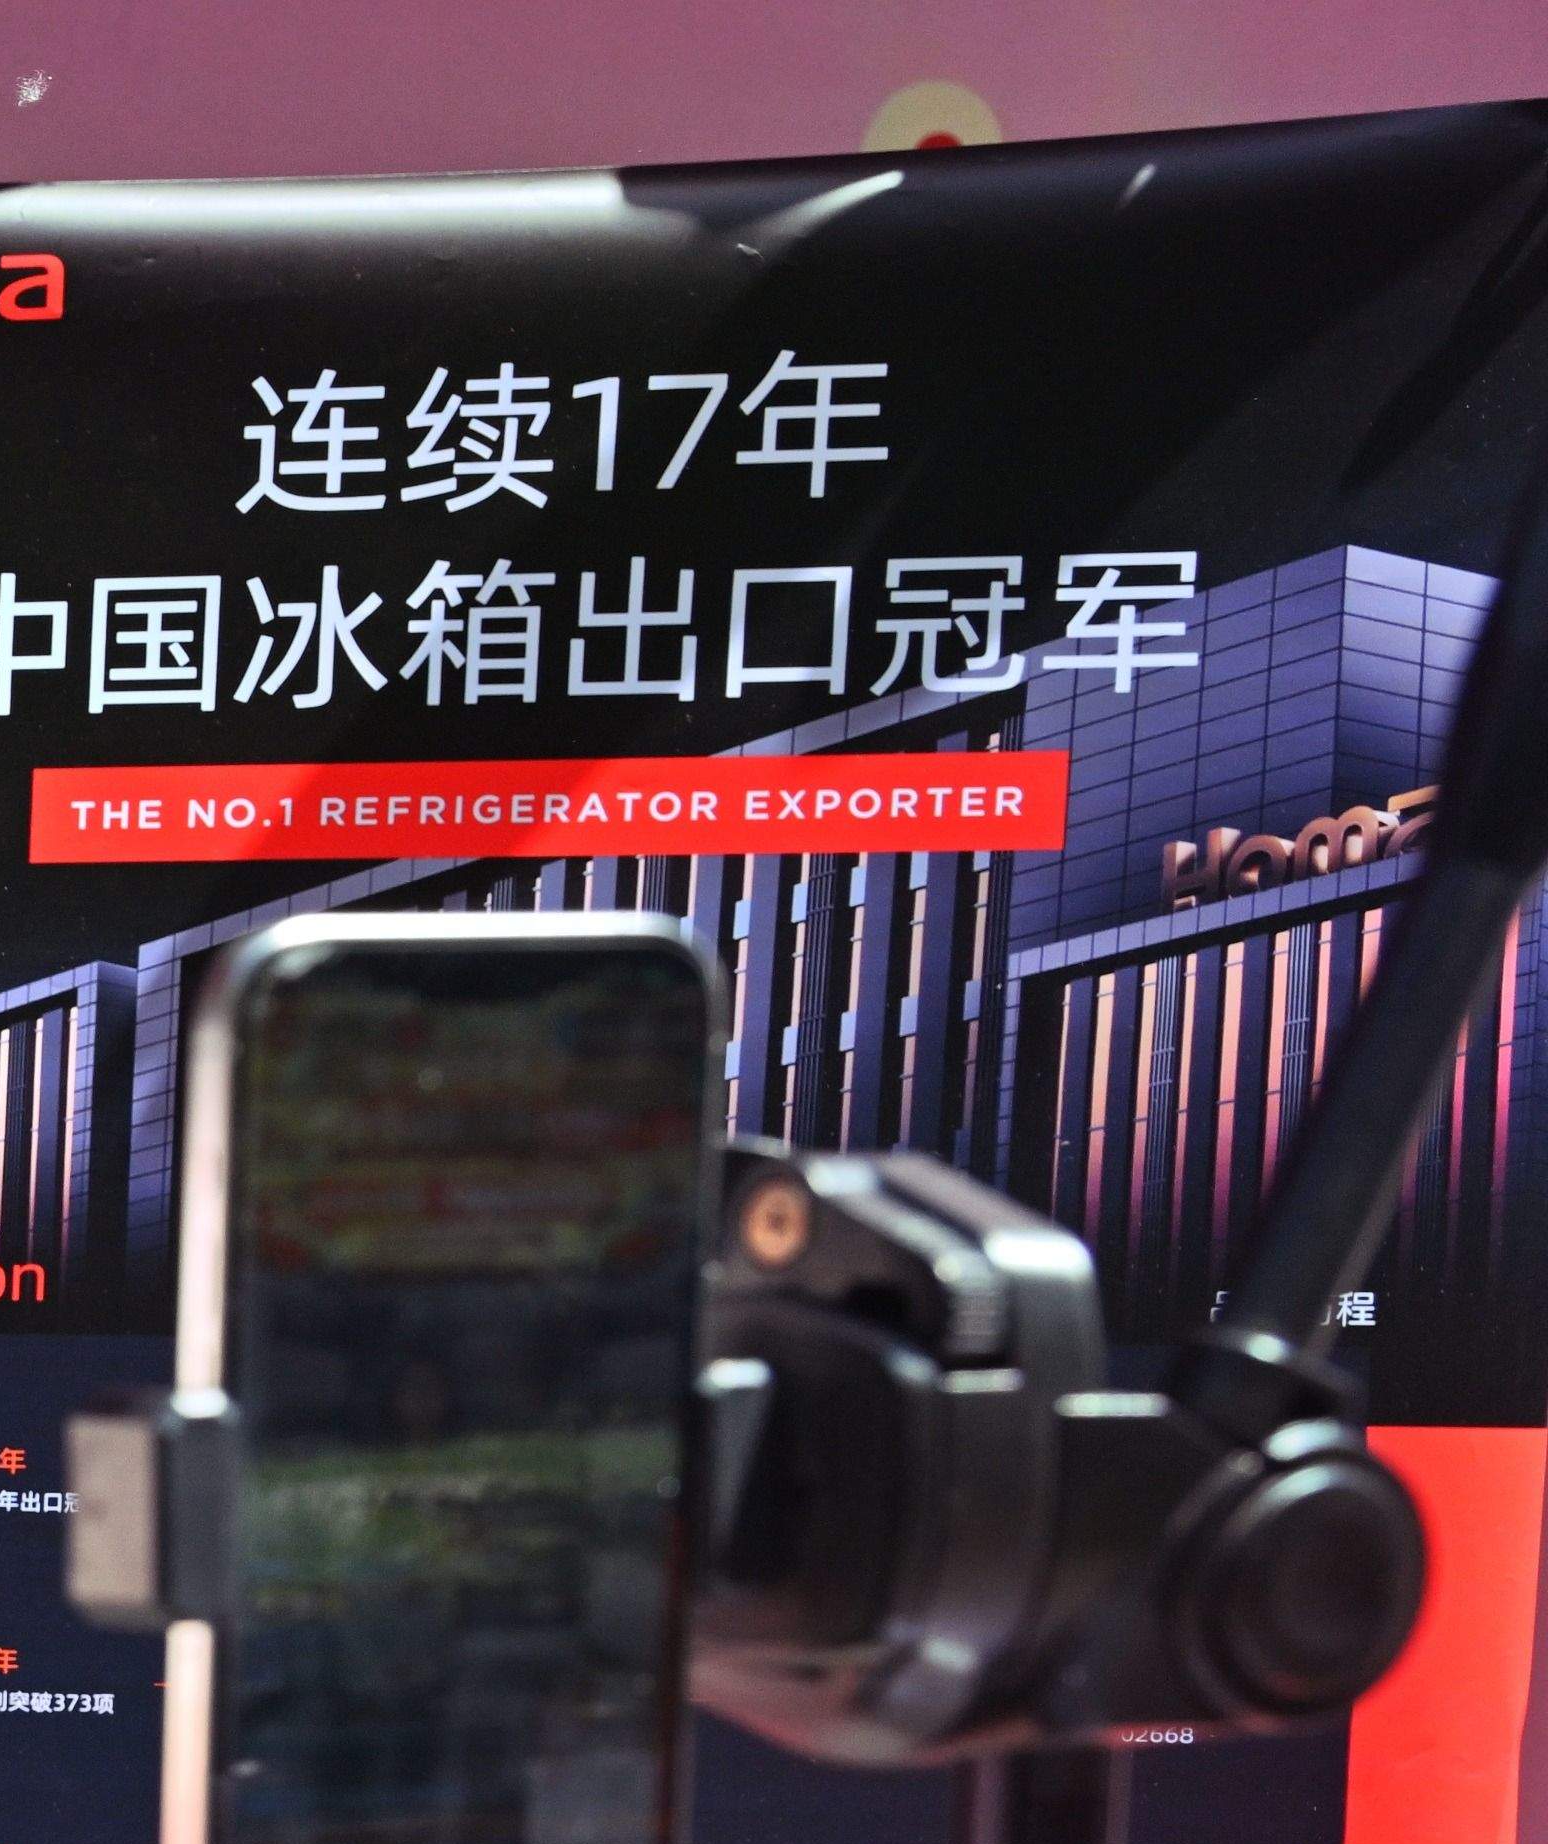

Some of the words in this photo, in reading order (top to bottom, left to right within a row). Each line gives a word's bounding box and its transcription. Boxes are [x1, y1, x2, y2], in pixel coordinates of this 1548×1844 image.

[236, 351, 889, 514] 连续17年
[71, 801, 162, 832] THE
[186, 798, 294, 830] NO.1
[319, 790, 718, 827] REFRIGERATOR
[745, 785, 1025, 820] EXPORTER
